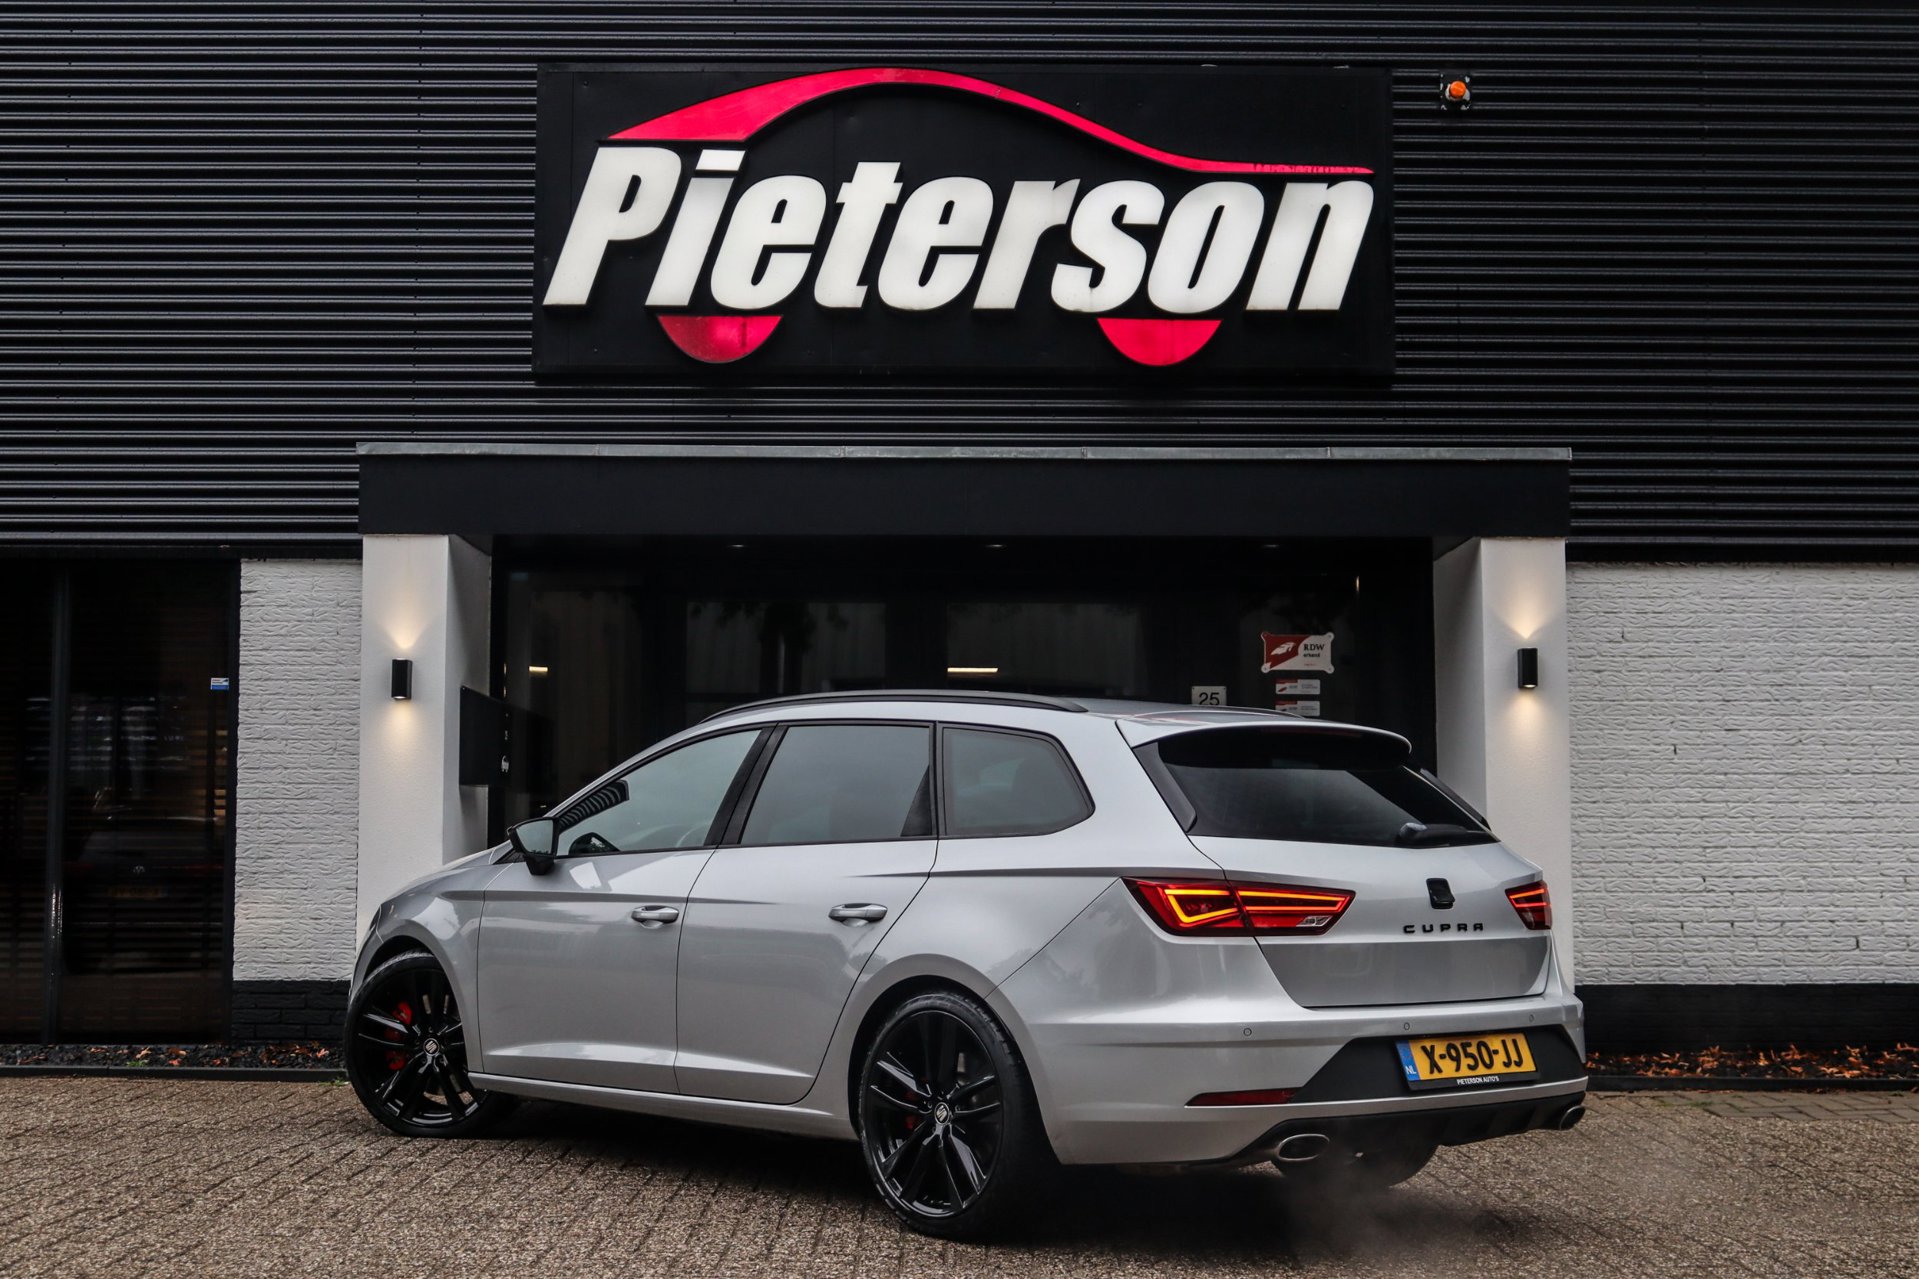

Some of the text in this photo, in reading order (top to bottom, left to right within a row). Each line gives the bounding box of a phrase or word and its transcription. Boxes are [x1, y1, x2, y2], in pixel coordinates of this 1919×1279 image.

[543, 146, 1375, 313] Pieterson
[1303, 643, 1325, 651] RDW
[1199, 692, 1220, 705] 25
[1403, 922, 1484, 934] CUPRA
[1420, 1038, 1525, 1075] X-950-JJ
[1405, 1065, 1417, 1075] NL
[1457, 1077, 1483, 1085] PIETERSON
